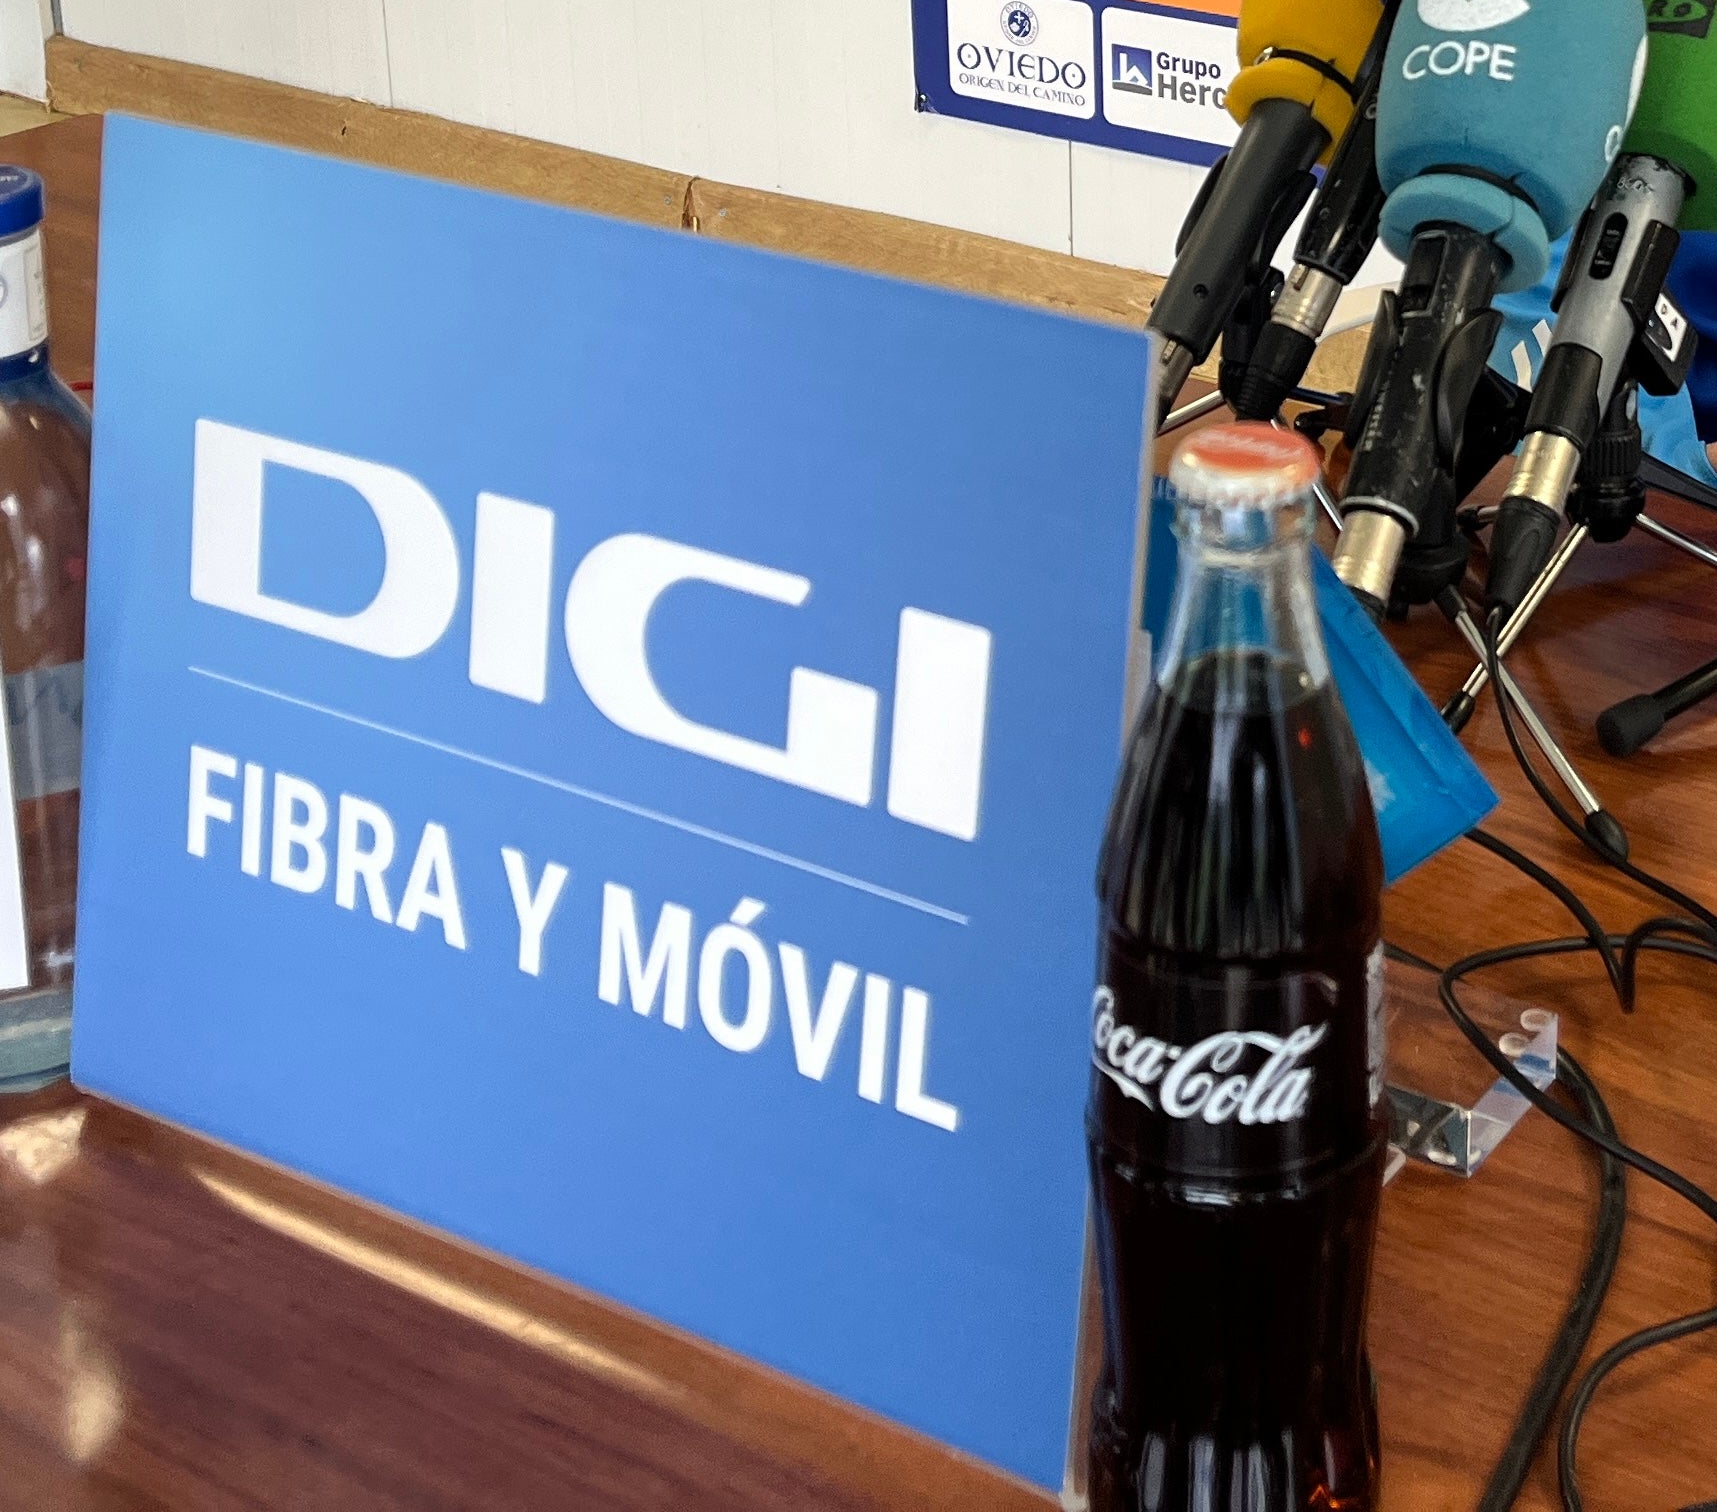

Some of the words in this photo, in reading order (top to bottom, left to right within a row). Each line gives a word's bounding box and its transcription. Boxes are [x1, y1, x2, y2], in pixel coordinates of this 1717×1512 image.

[957, 43, 1086, 89] OVIEDO
[1156, 52, 1221, 80] Grupo
[1403, 41, 1518, 81] COPE
[959, 73, 1005, 92] ORIGEN
[1008, 81, 1030, 98] DEL
[1033, 87, 1085, 106] CAMINO
[1157, 73, 1226, 109] Herc
[189, 418, 991, 841] DIGI
[187, 744, 470, 949] FIBRA
[500, 845, 569, 977] Y
[598, 880, 960, 1131] MÓVIL
